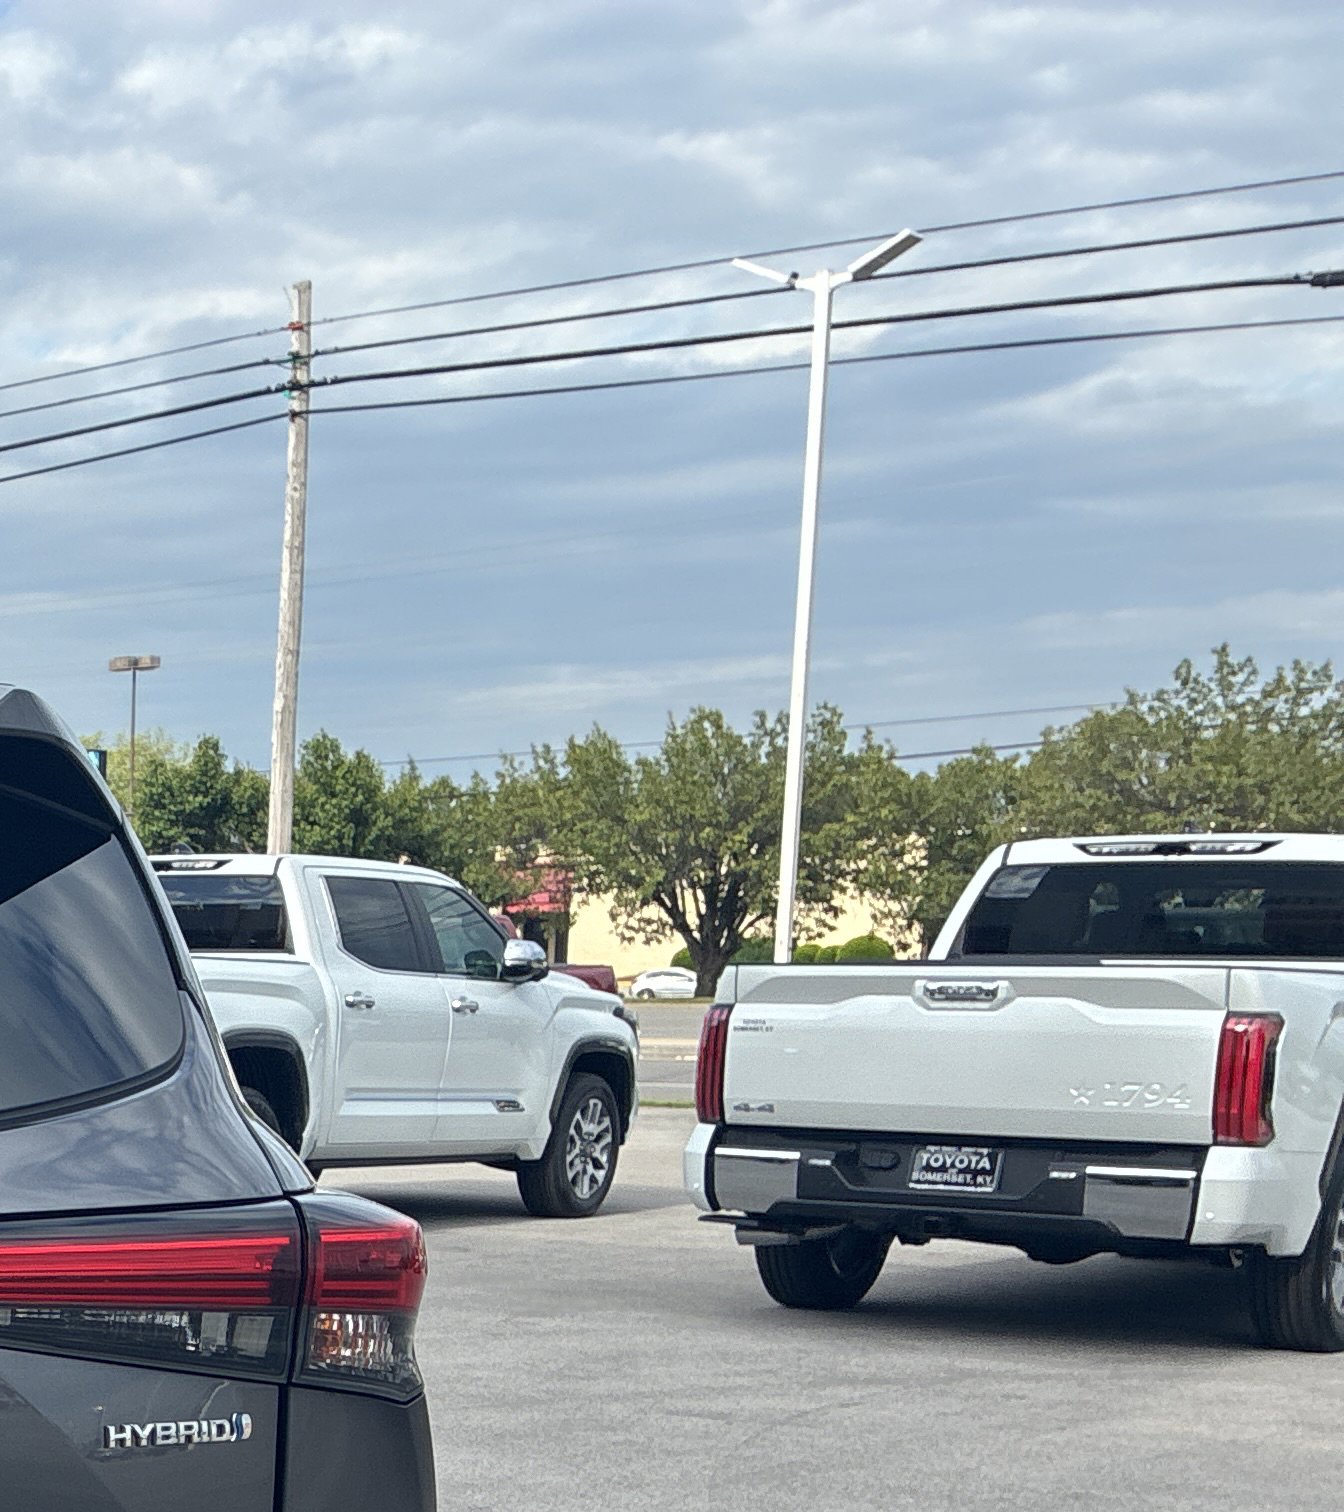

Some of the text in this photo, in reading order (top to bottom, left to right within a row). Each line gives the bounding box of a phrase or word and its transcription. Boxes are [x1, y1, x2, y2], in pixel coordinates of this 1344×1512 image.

[1103, 1082, 1191, 1109] 1794
[921, 1153, 991, 1171] TOYOTA
[105, 1419, 234, 1448] HYBRID
